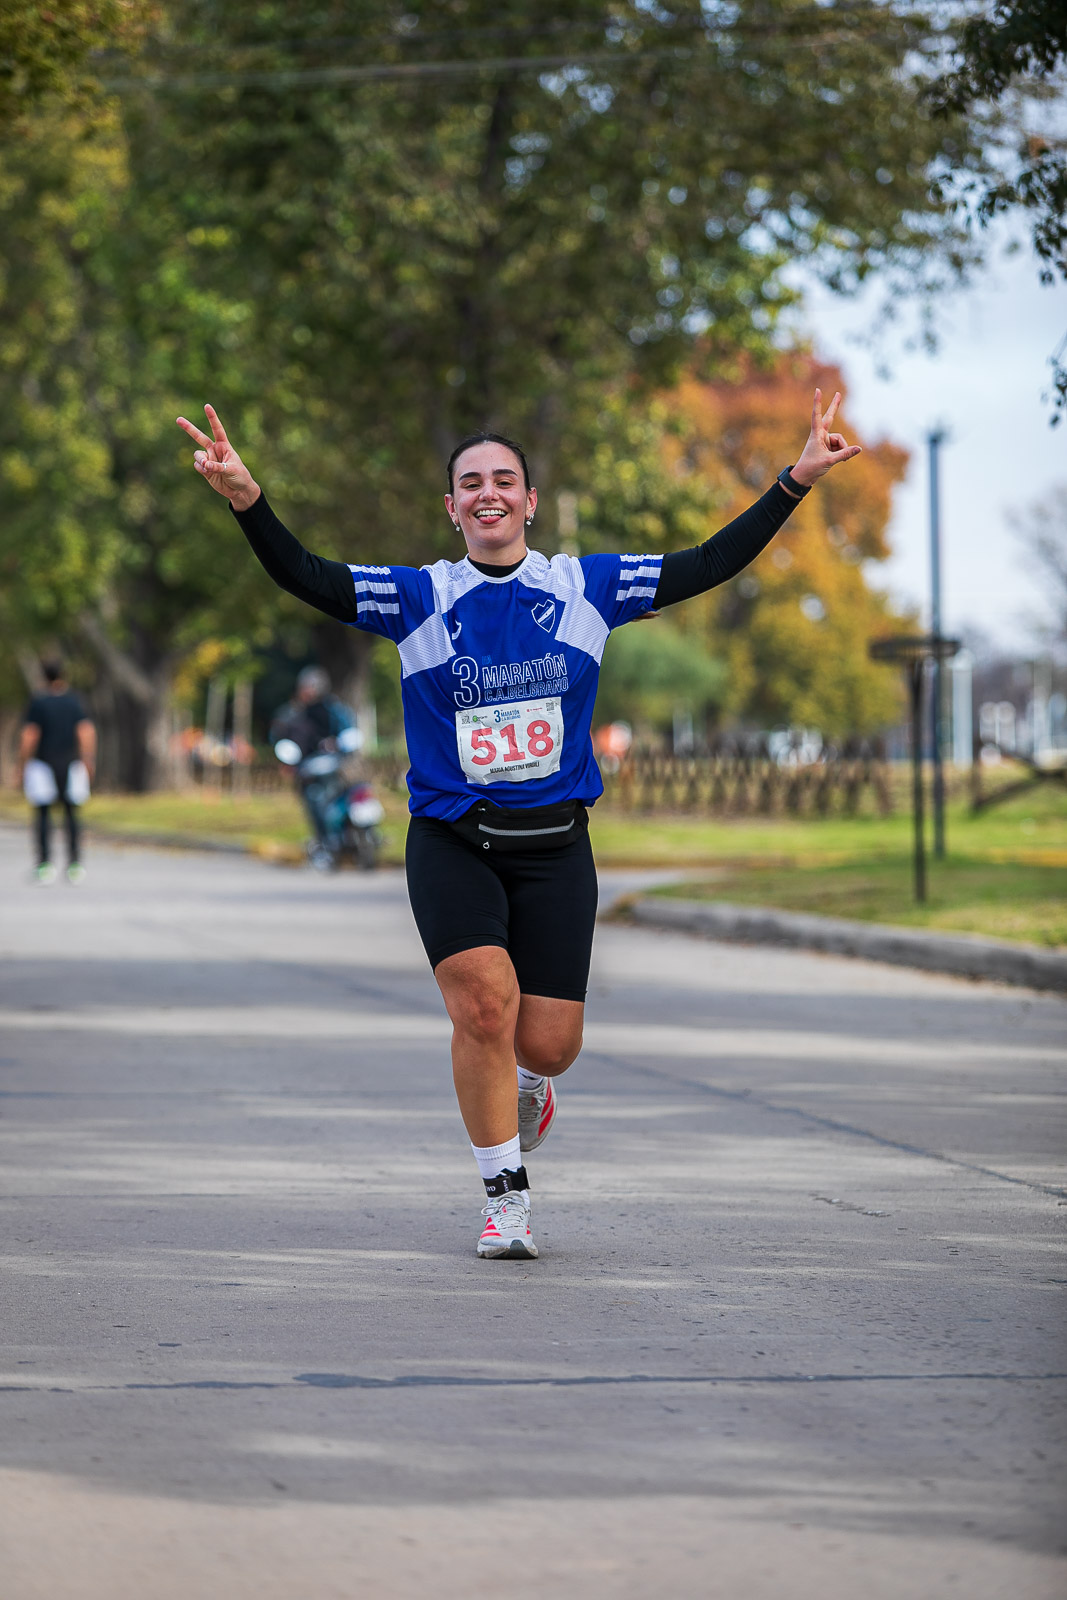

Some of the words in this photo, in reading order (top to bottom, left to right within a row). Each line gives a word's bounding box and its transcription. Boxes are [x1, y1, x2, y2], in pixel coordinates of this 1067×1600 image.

[452, 656, 481, 709] 3
[482, 653, 568, 689] MARATÓN
[493, 709, 501, 723] 3
[471, 719, 554, 766] 518
